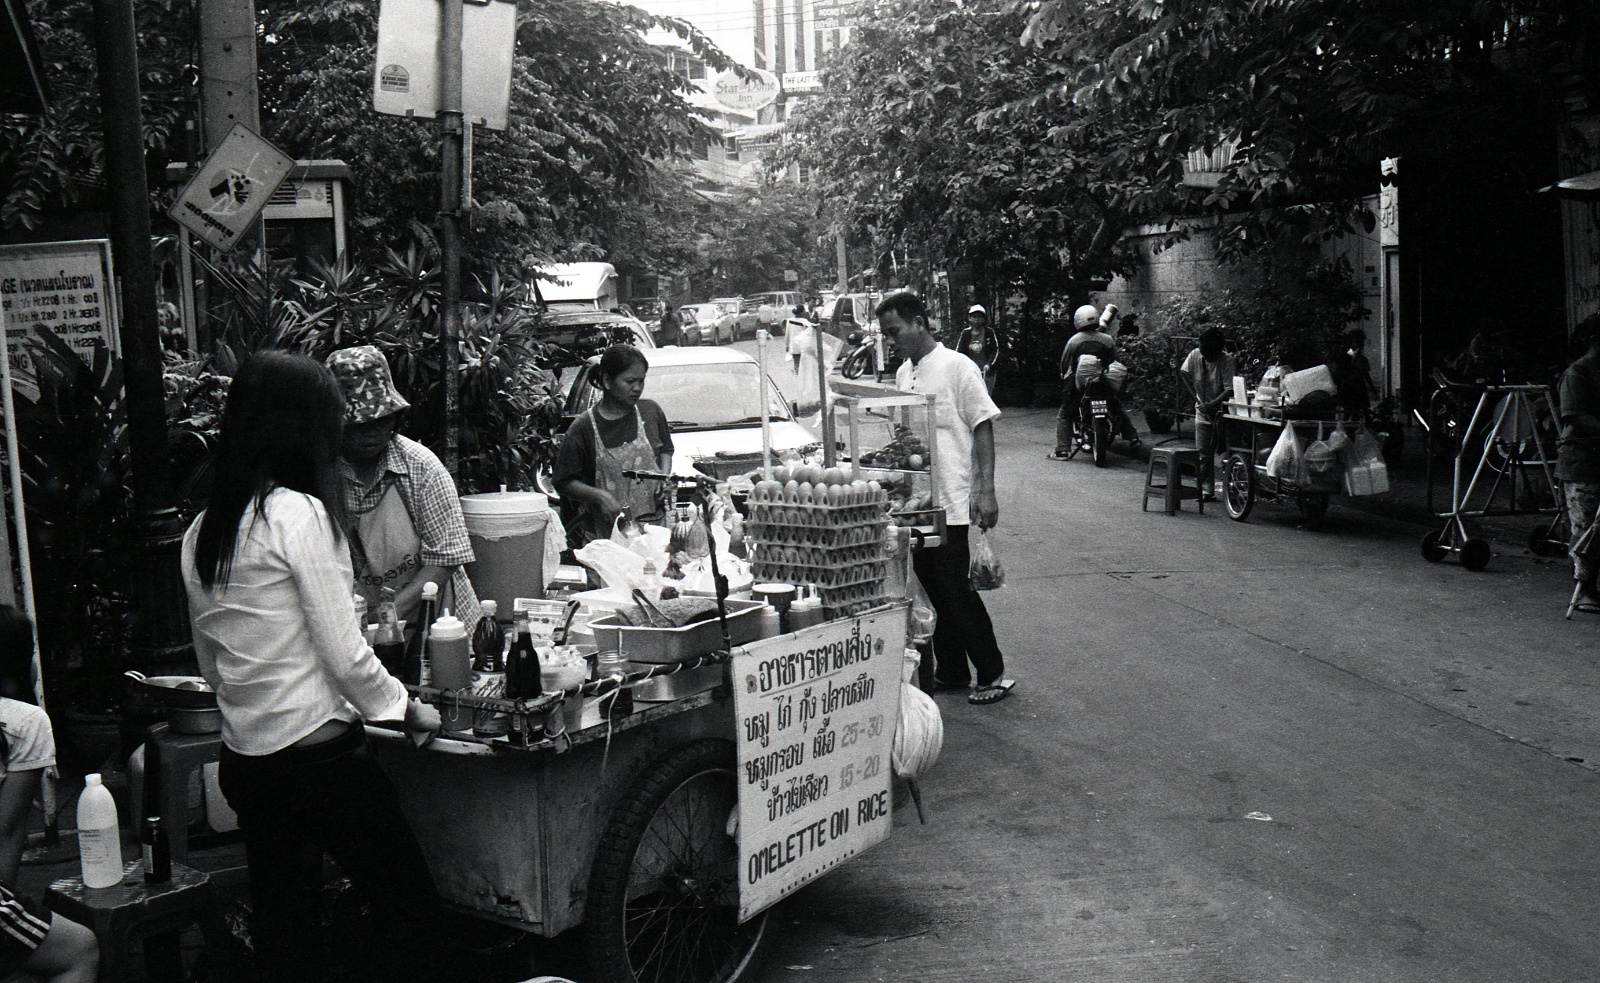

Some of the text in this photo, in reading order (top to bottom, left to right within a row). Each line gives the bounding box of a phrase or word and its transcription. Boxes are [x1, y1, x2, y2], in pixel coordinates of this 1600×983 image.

[716, 80, 739, 94] Star
[738, 94, 753, 103] Inn
[797, 75, 811, 84] LAST
[758, 619, 872, 692] อาหารตามสั่ง
[744, 672, 875, 748] หมู ไก่ กุ้ง ปลาหมึก
[746, 742, 804, 791] หมูกรอบ
[813, 716, 836, 759] เนื้อ
[767, 773, 828, 822] ข้าวไข่เจียว
[748, 790, 888, 885] OMELETTE ON RICE
